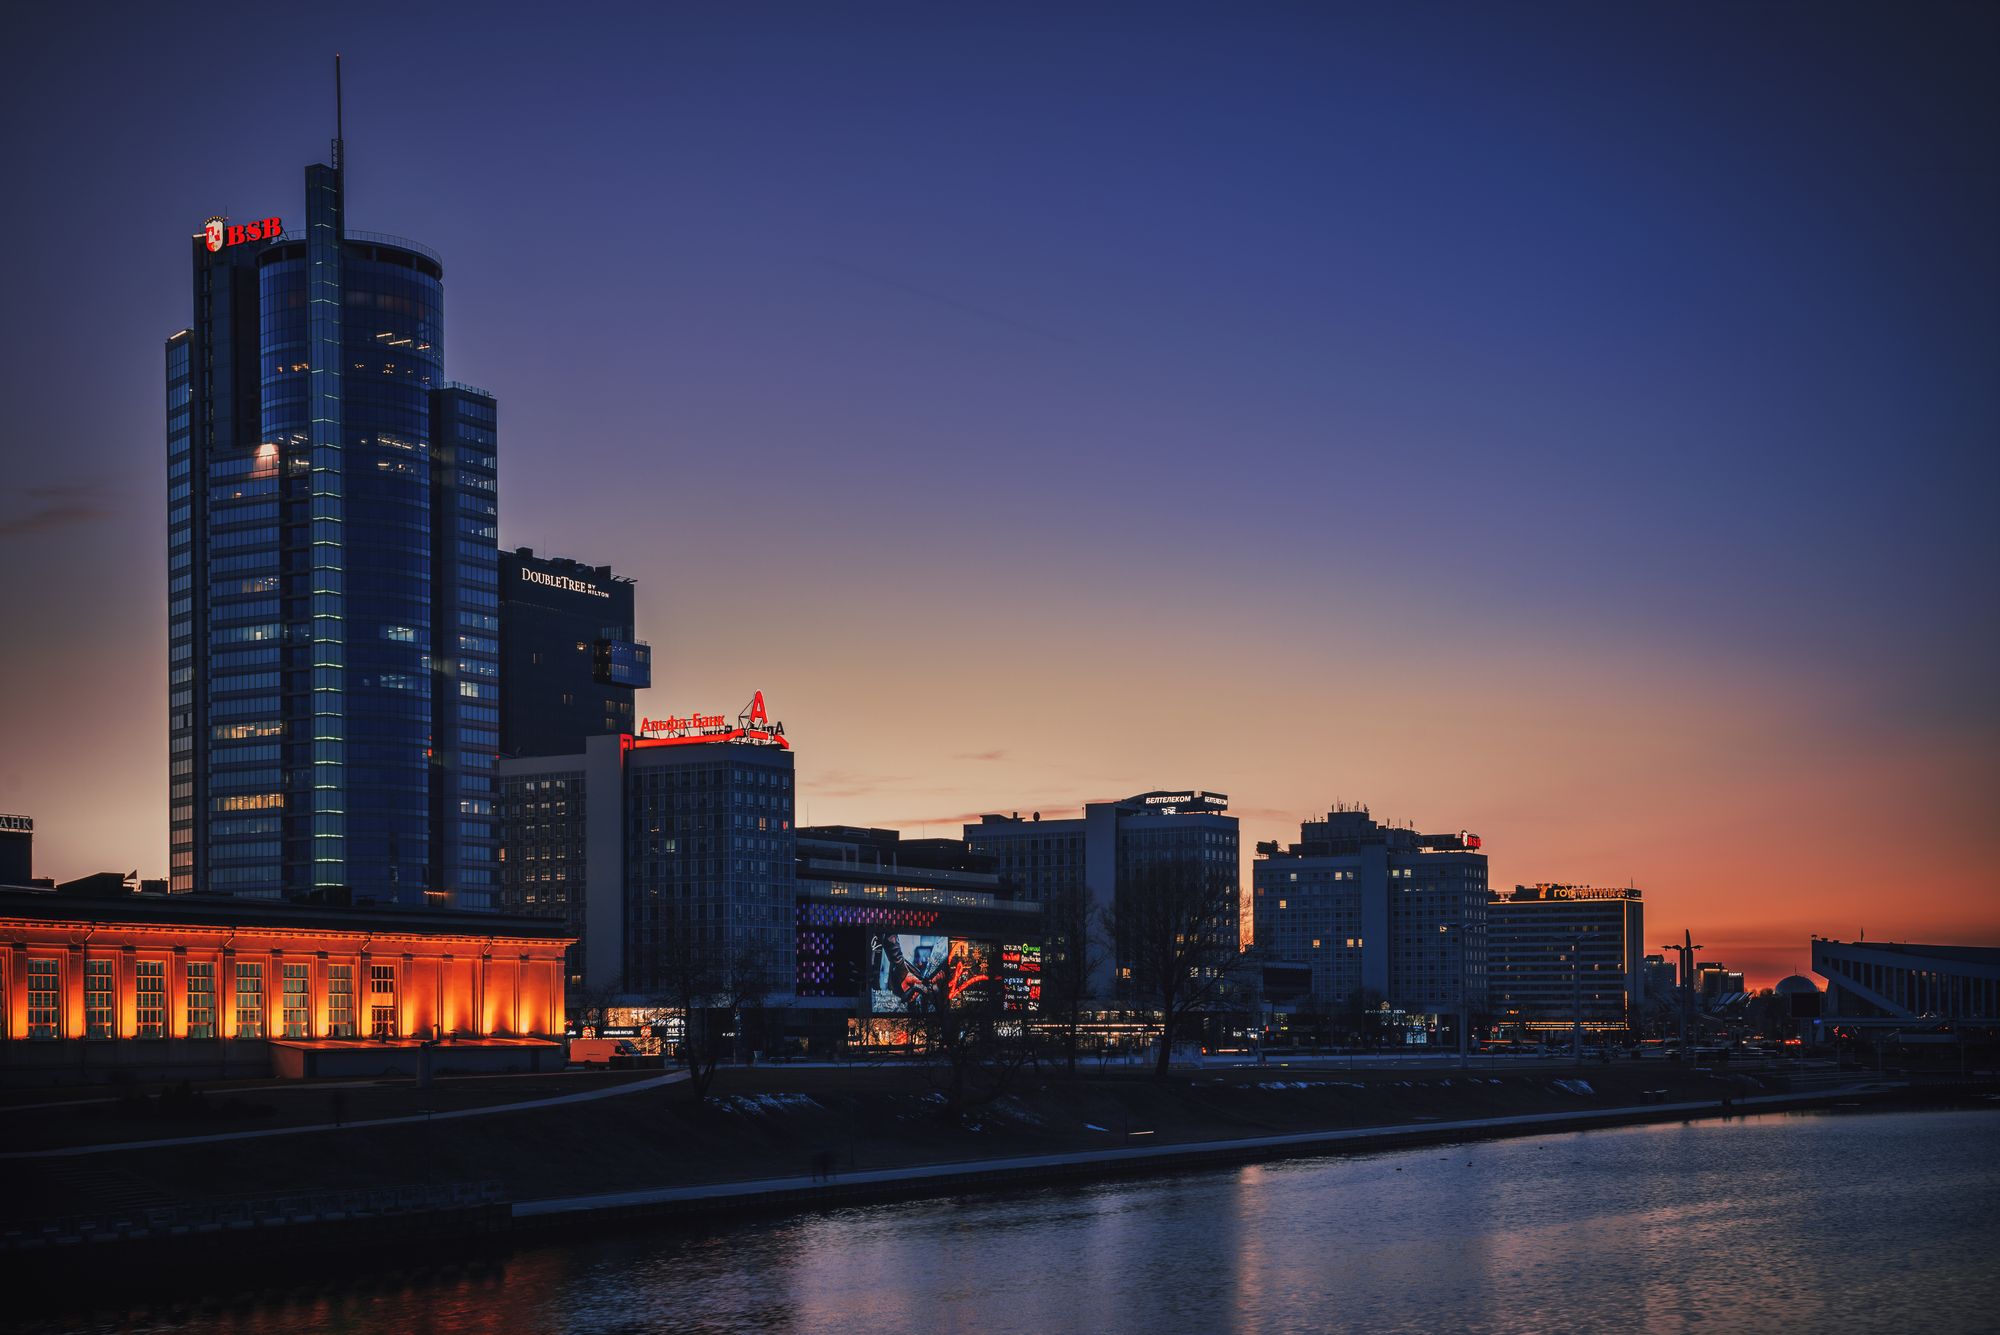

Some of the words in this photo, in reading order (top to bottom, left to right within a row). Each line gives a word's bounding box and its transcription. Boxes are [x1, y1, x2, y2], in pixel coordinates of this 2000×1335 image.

[226, 217, 282, 247] BSB
[587, 589, 610, 599] HILTON
[1145, 796, 1191, 804] БЕЛТЕЛЕКОМ
